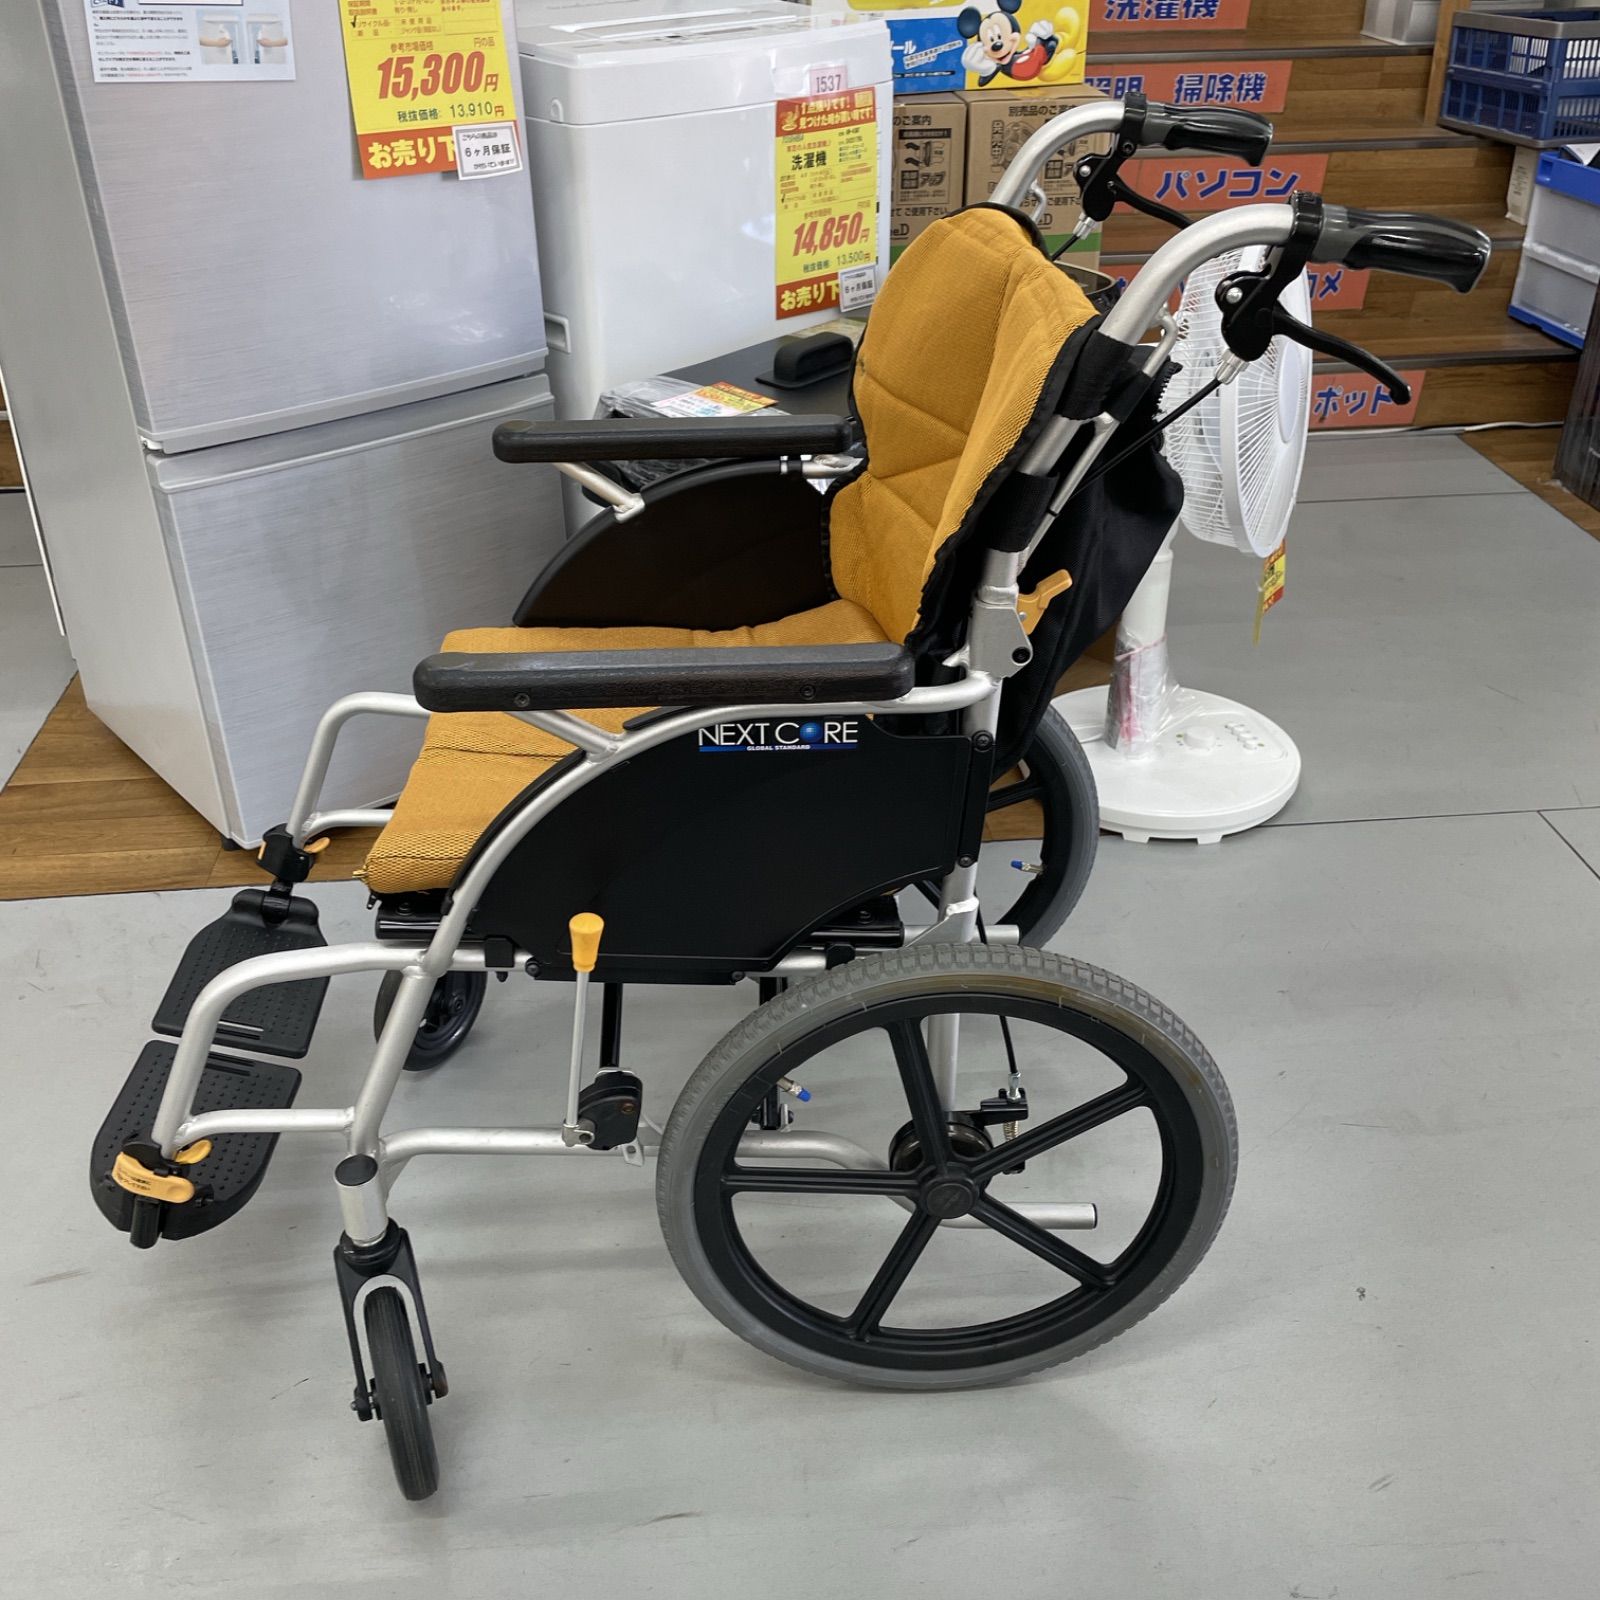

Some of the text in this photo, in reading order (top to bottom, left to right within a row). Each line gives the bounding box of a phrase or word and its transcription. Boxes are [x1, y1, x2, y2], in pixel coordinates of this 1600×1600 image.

[816, 74, 842, 93] 1537
[1174, 72, 1267, 104] 掃除機
[791, 150, 828, 171] 洗濯機
[1155, 167, 1299, 199] パソコン
[1314, 384, 1393, 416] ポット
[698, 722, 770, 746] NEXT
